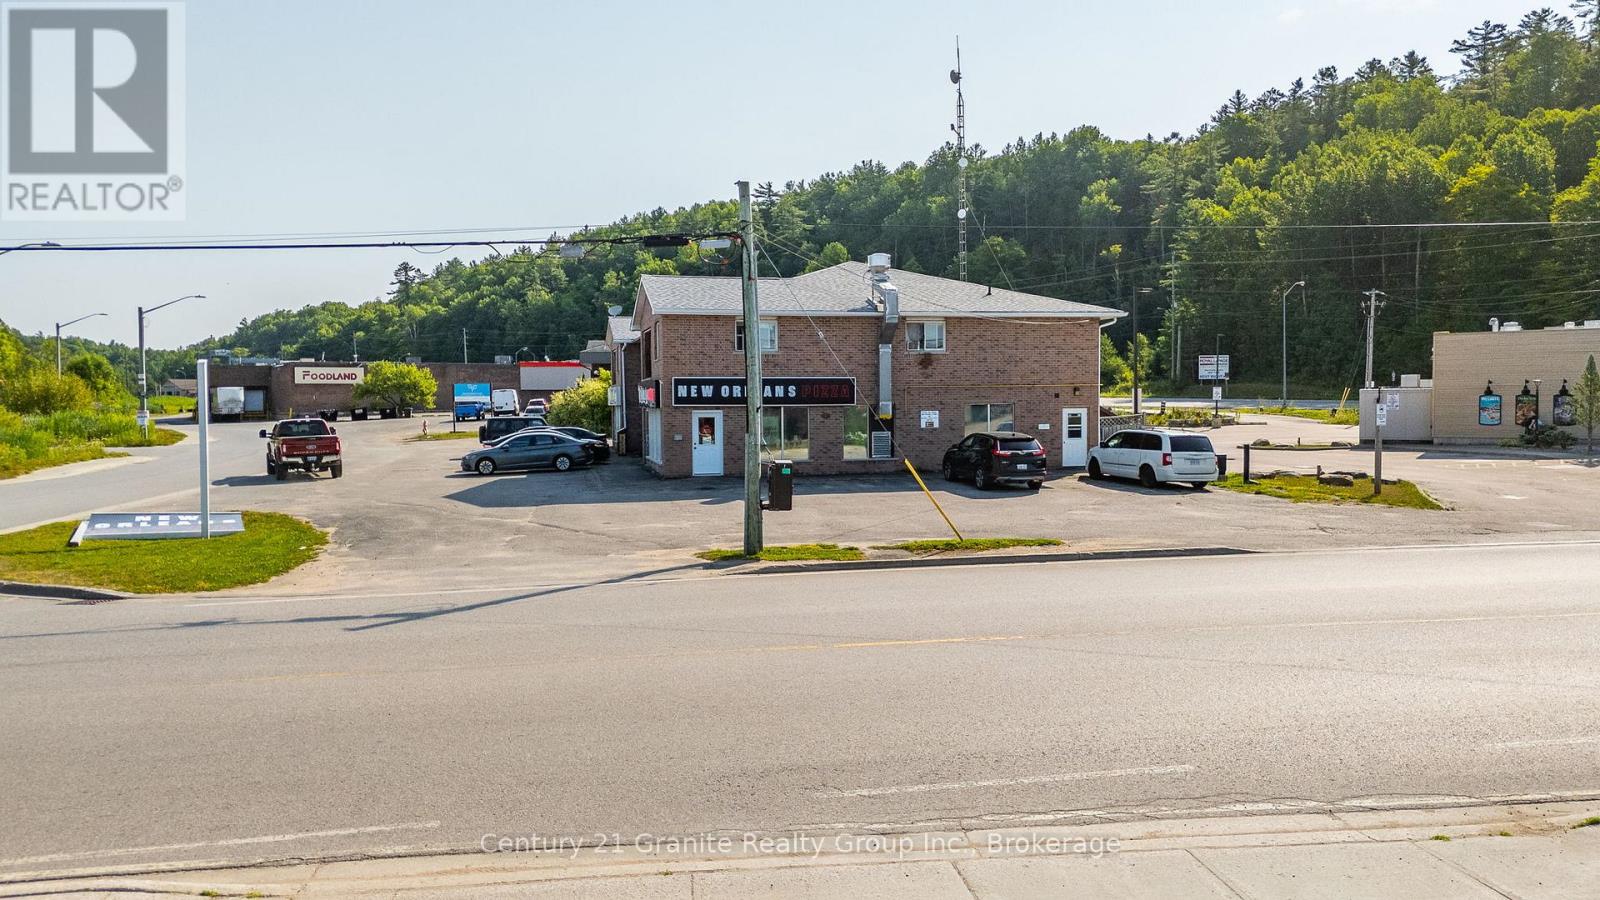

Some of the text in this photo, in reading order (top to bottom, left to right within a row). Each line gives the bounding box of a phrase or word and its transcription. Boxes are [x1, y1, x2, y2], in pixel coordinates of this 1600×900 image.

[302, 370, 358, 381] FOODLAND
[677, 385, 714, 398] NEW
[721, 385, 797, 398] ORANS
